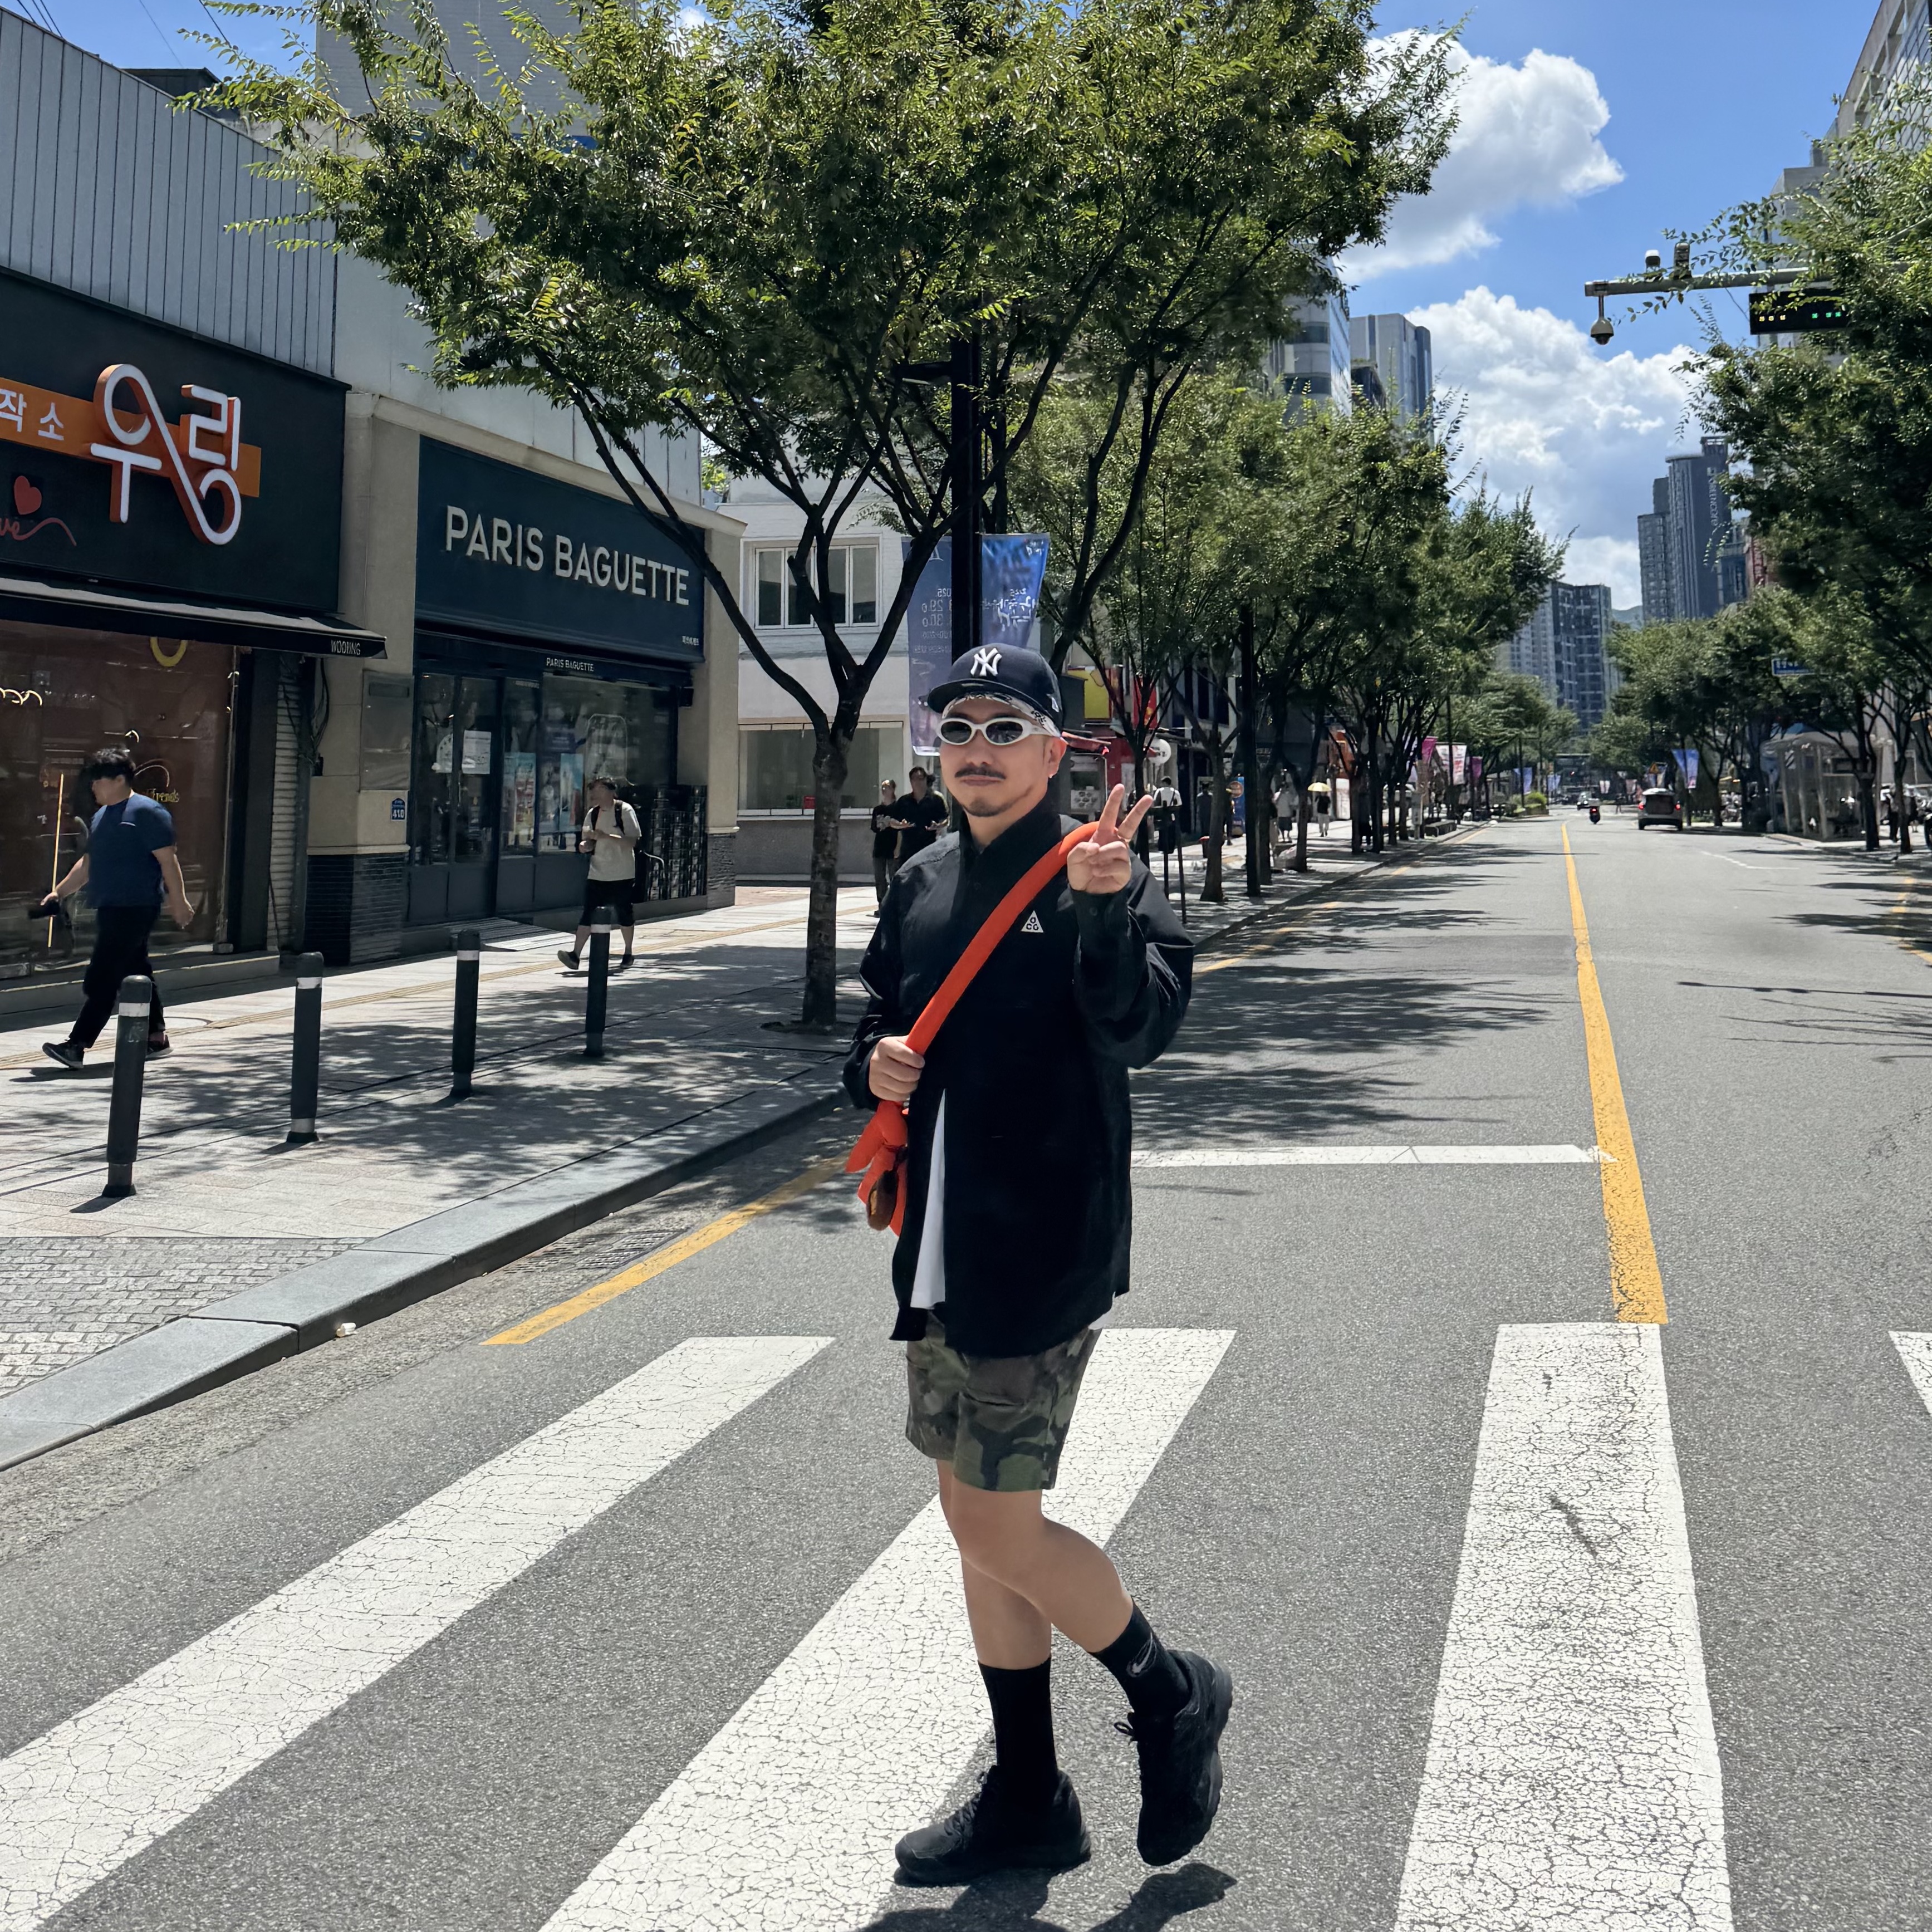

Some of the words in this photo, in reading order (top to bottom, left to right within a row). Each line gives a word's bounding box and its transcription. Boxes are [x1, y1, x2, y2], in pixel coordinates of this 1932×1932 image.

[446, 505, 543, 571] PARIS
[556, 535, 689, 605] BAGUETTE
[546, 658, 564, 668] PARIS
[565, 660, 594, 671] BAGUETTE
[970, 648, 1002, 676] NY
